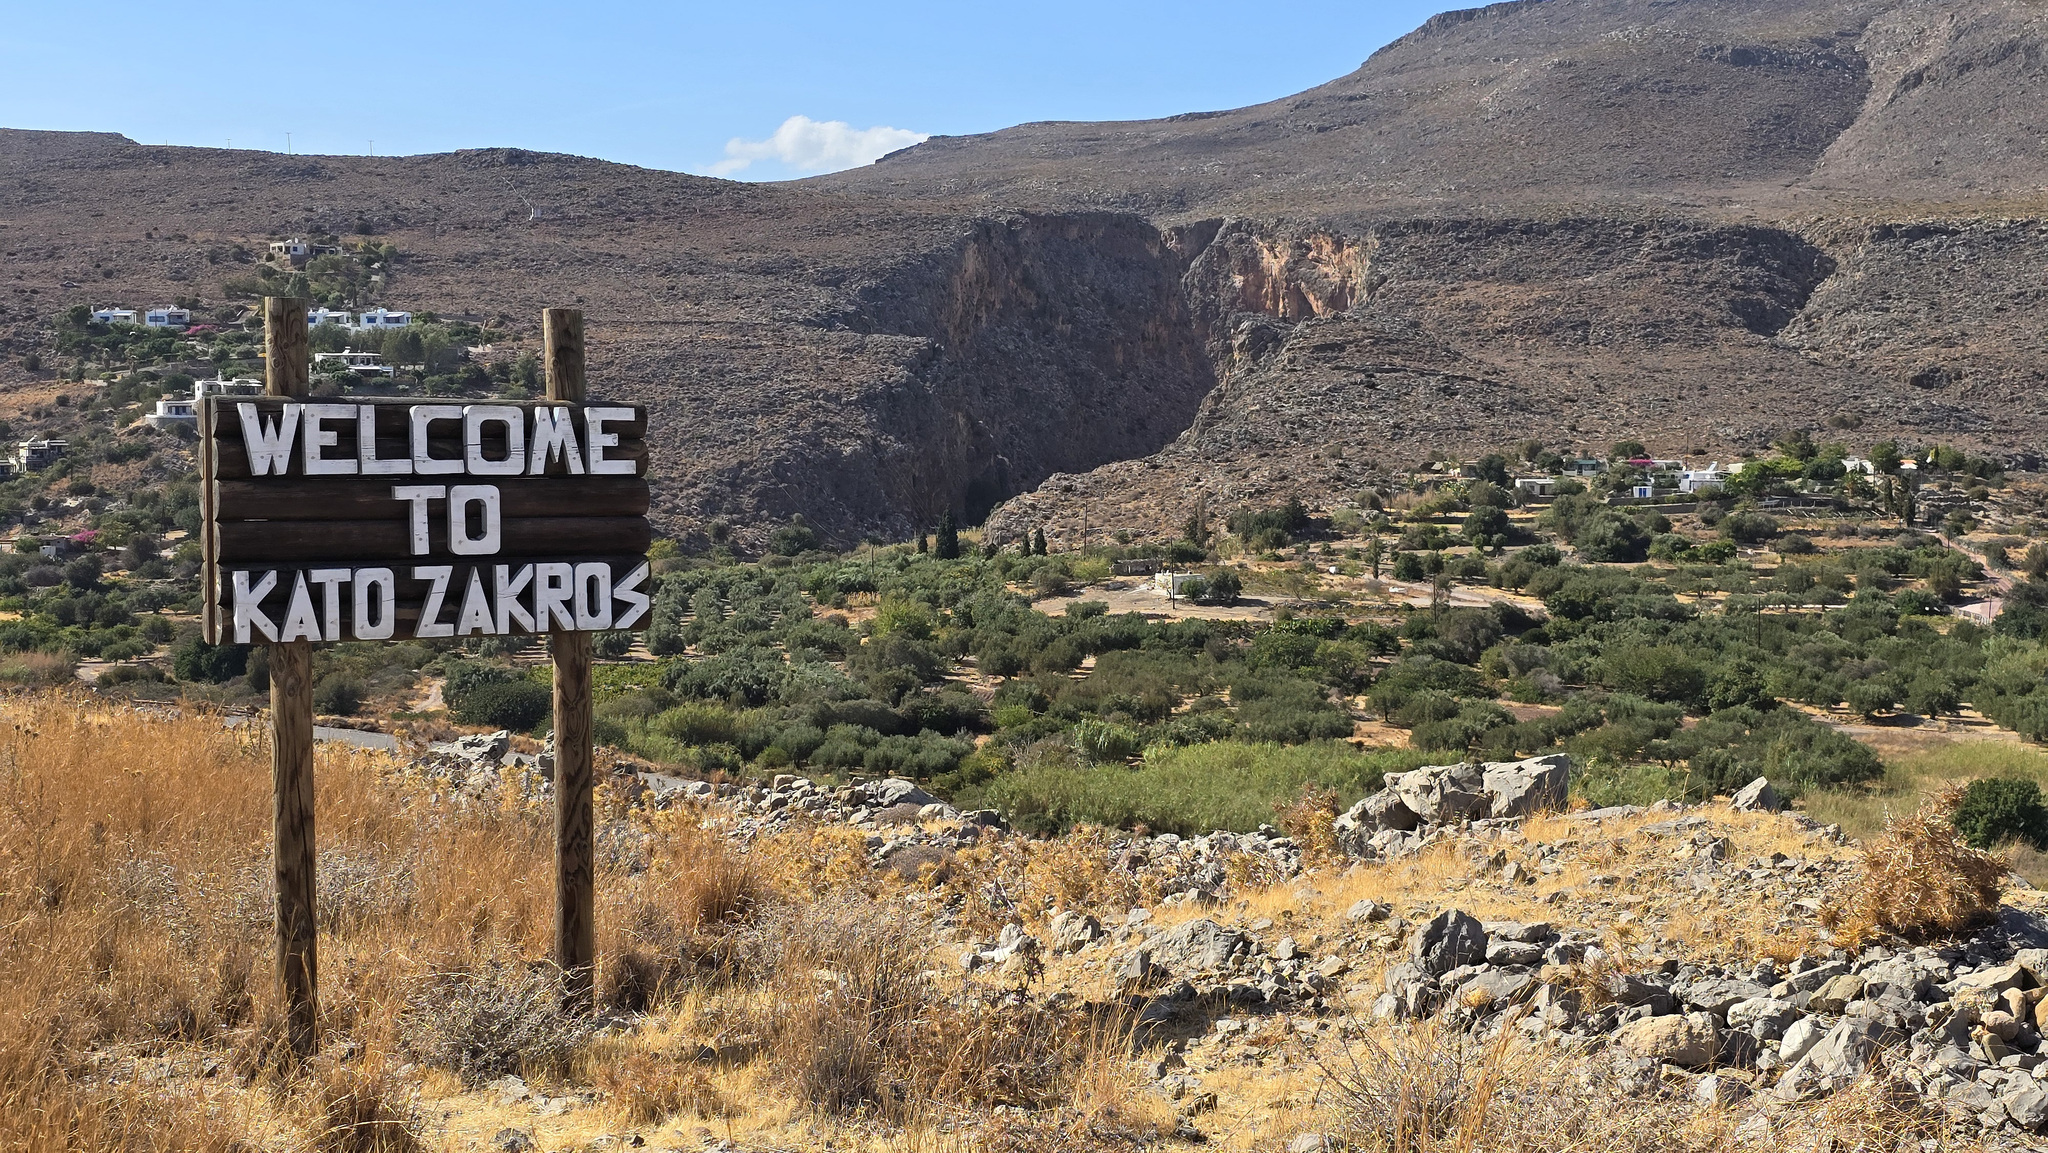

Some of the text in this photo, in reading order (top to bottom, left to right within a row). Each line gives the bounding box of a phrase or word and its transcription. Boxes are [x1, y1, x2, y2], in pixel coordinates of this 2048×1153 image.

[237, 403, 636, 476] WELCOME
[392, 484, 501, 556] TO
[232, 561, 650, 644] KATO ZAKROS
